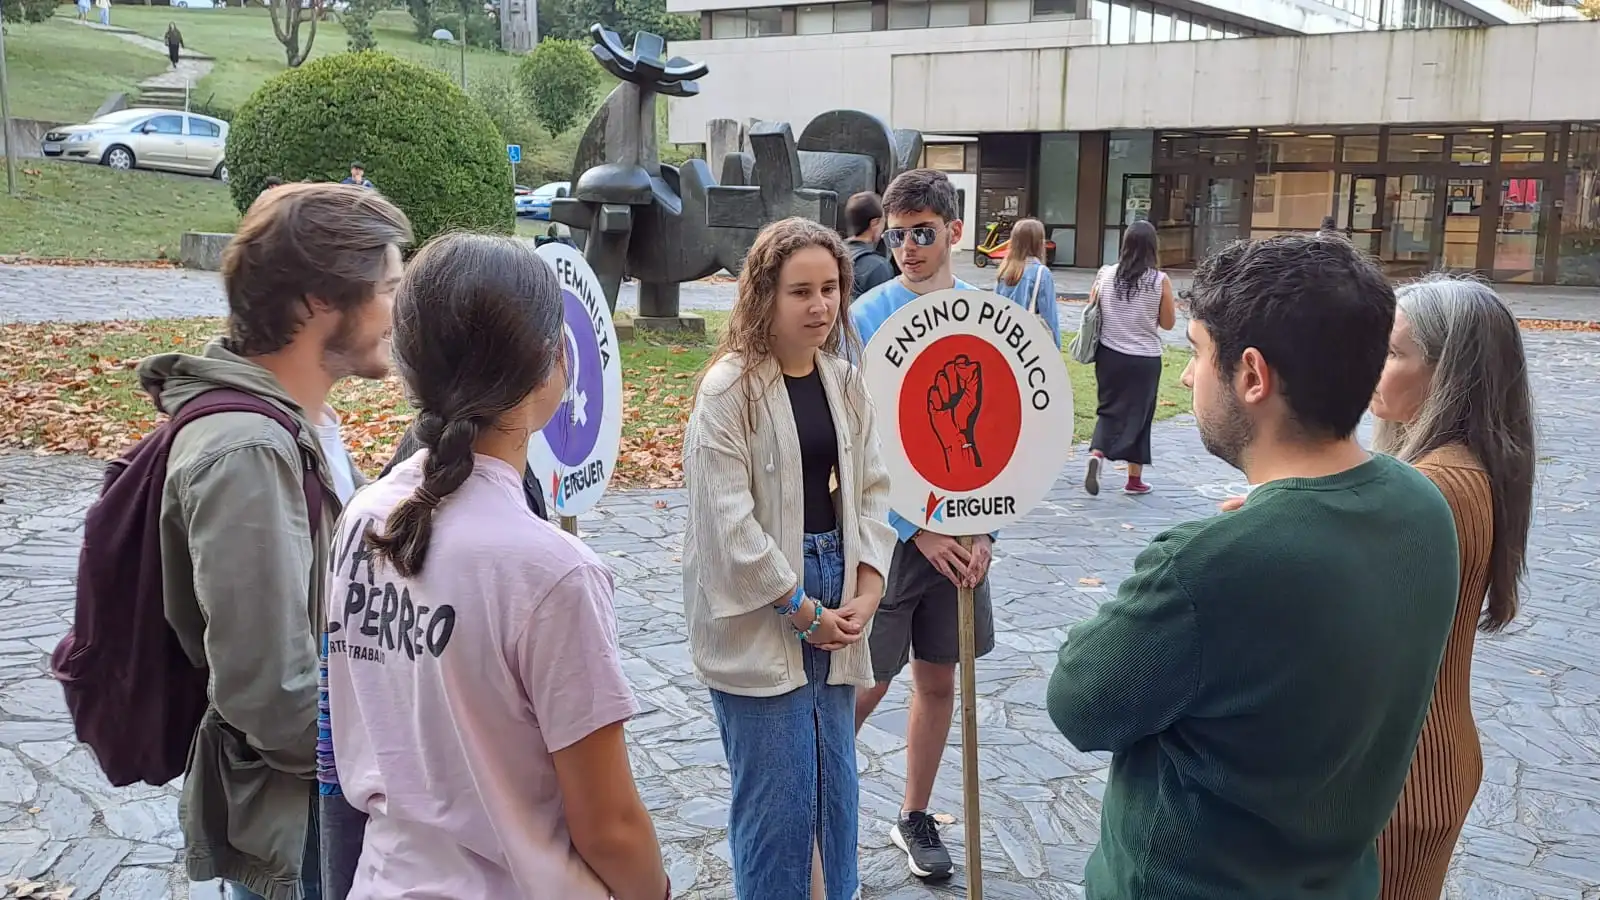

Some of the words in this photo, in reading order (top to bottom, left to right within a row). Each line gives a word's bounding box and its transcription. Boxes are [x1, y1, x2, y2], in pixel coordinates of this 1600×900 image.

[556, 257, 611, 372] FEMINISTA
[884, 298, 970, 369] ENSINO
[978, 301, 1050, 411] PÚBLICO
[563, 459, 605, 501] ERGUER
[946, 496, 1016, 518] ERGUER
[343, 581, 456, 661] PERREO
